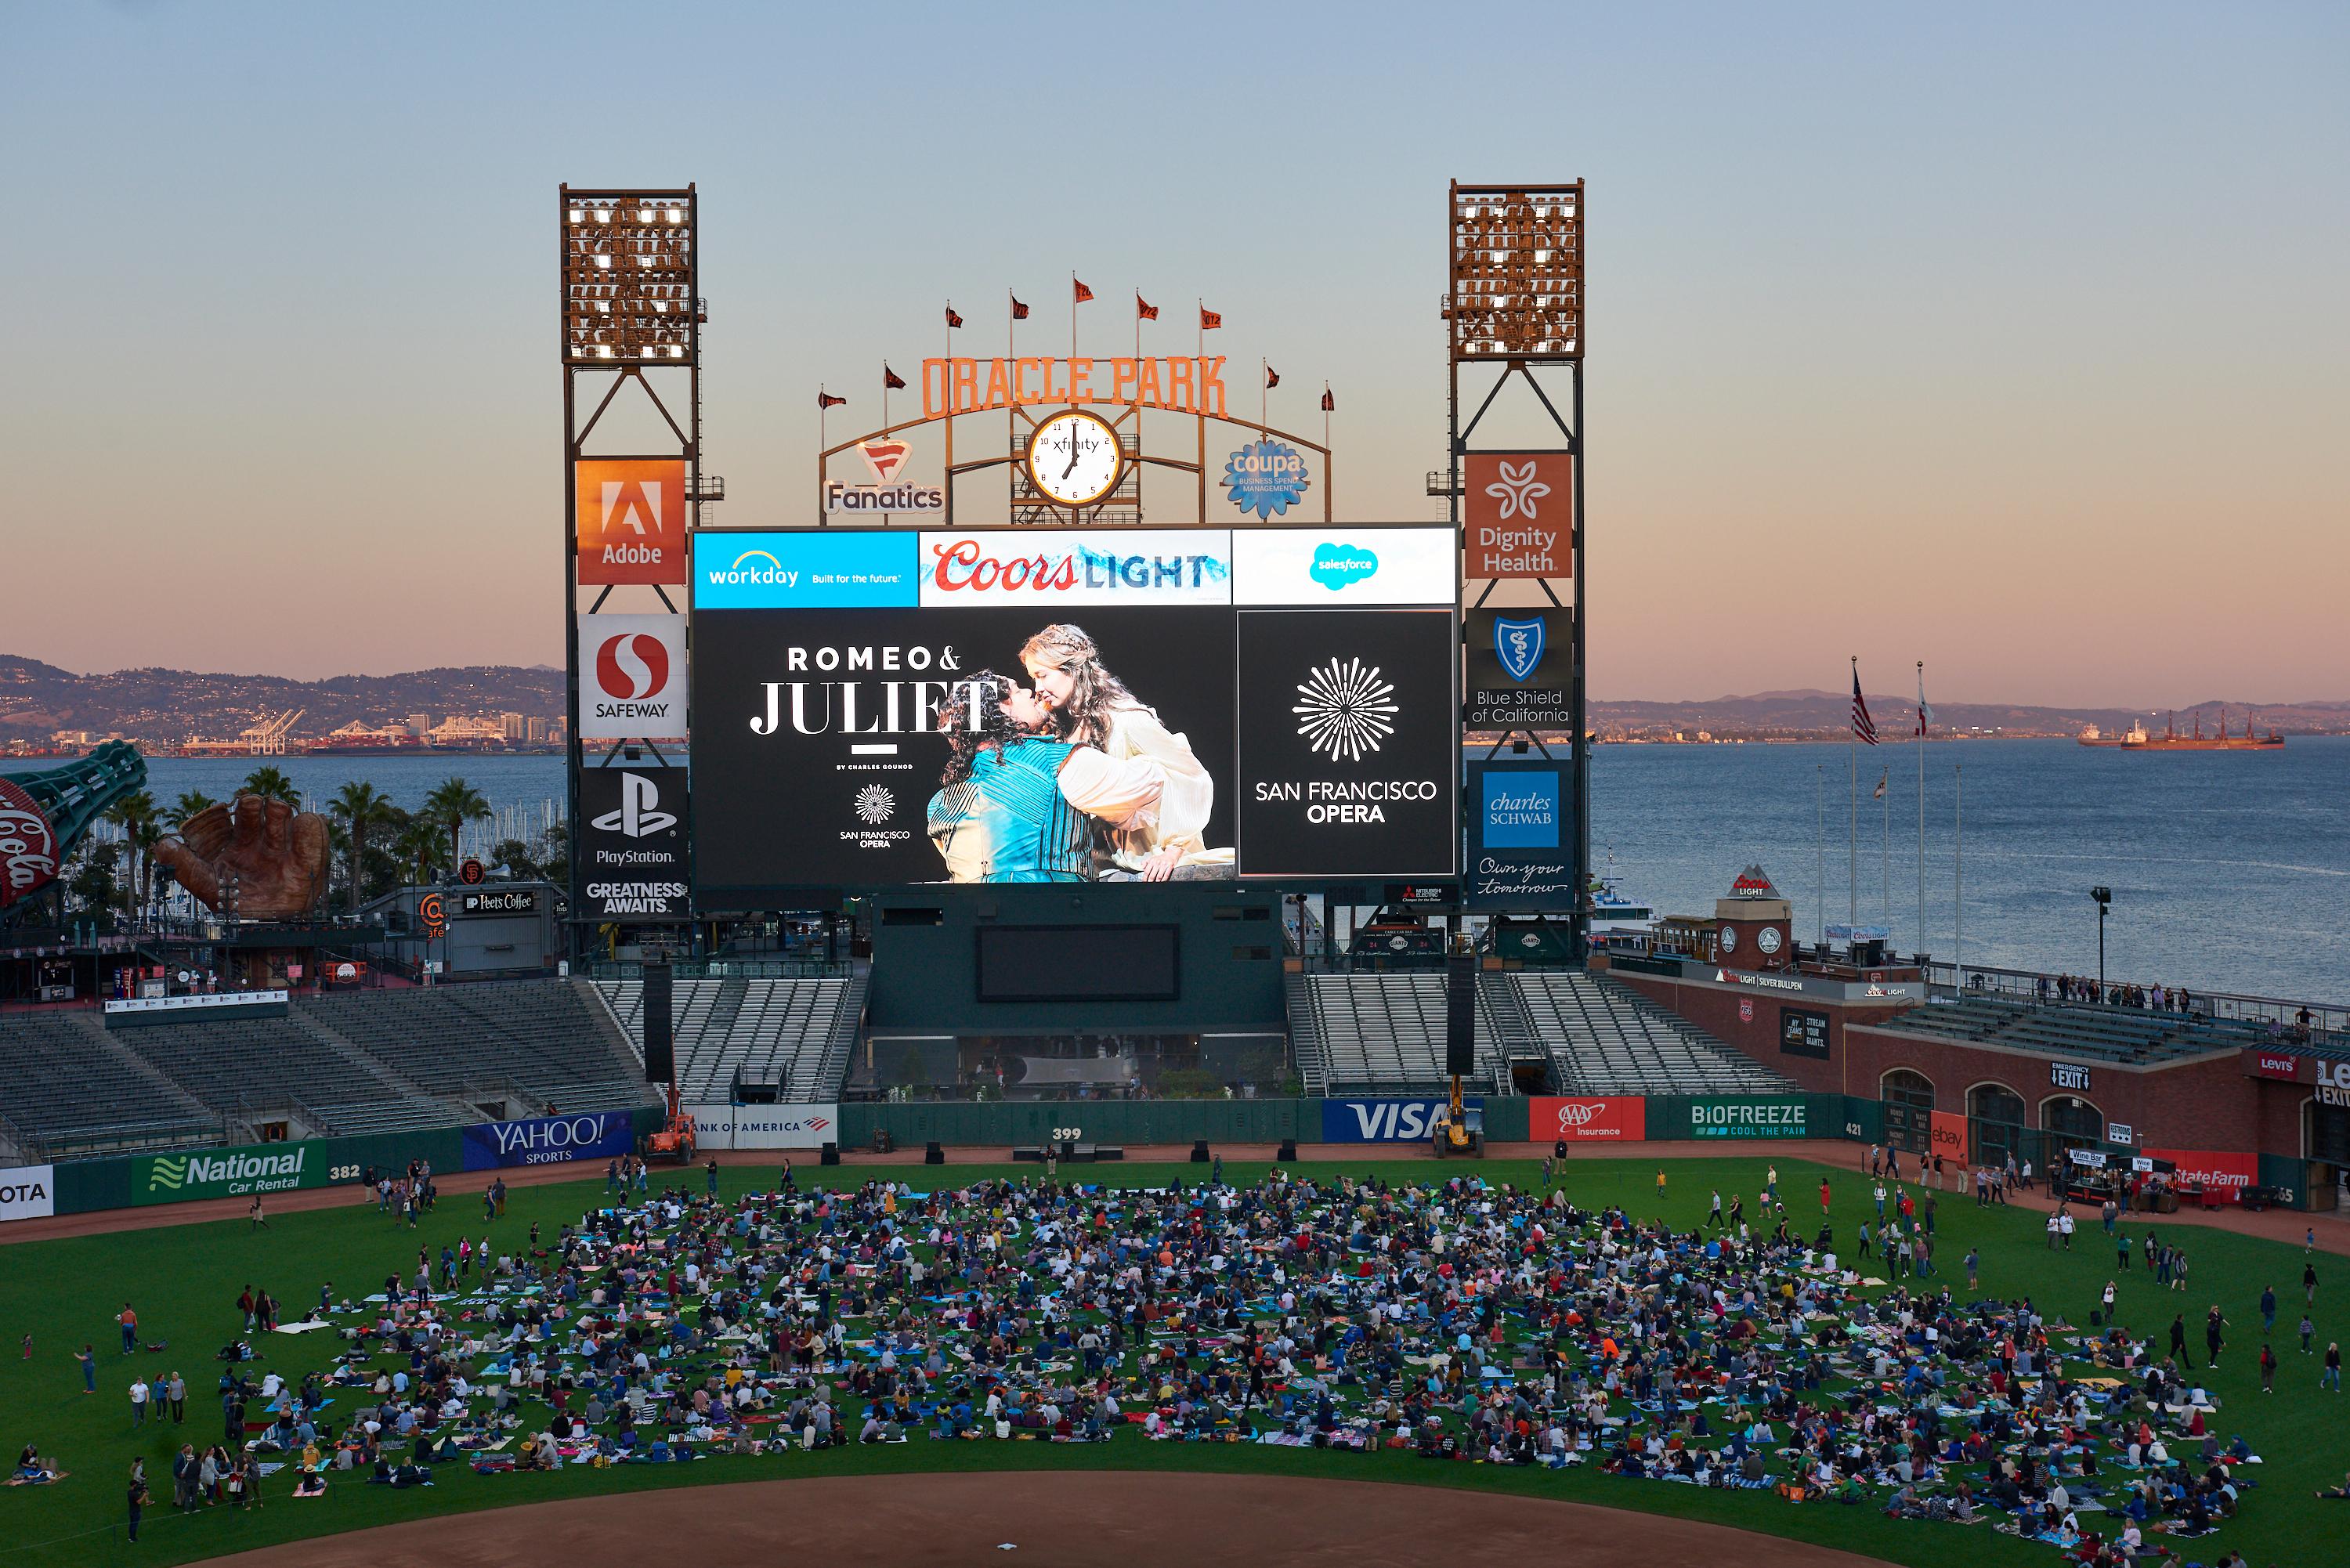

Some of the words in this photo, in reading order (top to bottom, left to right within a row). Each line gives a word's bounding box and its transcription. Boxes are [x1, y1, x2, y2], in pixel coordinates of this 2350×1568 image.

[923, 357, 1094, 420] ORACLE
[1111, 356, 1228, 420] PARK
[1234, 454, 1300, 477] coupa
[828, 484, 942, 509] Fanatics
[1479, 526, 1557, 551] Dignity
[602, 542, 662, 564] Adobe
[933, 540, 1079, 591] Coors
[1086, 555, 1209, 588] LIGHT
[1318, 558, 1372, 572] salesforce
[1484, 551, 1554, 572] Health
[709, 566, 799, 587] workday
[812, 574, 833, 583] Built
[836, 574, 849, 583] for
[852, 574, 866, 583] the
[787, 645, 932, 671] ROMEO
[939, 645, 962, 671] &
[1477, 691, 1511, 705] Blue
[1515, 690, 1562, 705] Shield
[595, 703, 668, 718] SAFEWAY
[749, 681, 998, 736] JULIET
[1472, 707, 1488, 722] of
[1491, 707, 1569, 722] California
[1255, 782, 1300, 801] SAN
[1308, 780, 1437, 800] FRANCISCO
[1491, 792, 1551, 811] charles
[1307, 804, 1385, 824] OPERA
[1490, 813, 1552, 824] SCHWAB
[840, 831, 858, 840] SAN
[860, 830, 910, 840] FRANCISCO
[859, 840, 891, 848] OPERA
[596, 850, 672, 866] PlayStation
[1479, 857, 1518, 875] Own
[1520, 865, 1564, 882] your
[1733, 874, 1770, 889] Coors
[587, 882, 682, 898] GREATNESS
[479, 894, 503, 909] Peet's
[504, 893, 532, 910] Coffee
[603, 898, 667, 913] AWAITS
[1853, 930, 1872, 939] Coors
[1740, 974, 1756, 984] LIGHT
[1759, 977, 1778, 988] SILVER
[1777, 980, 1802, 990] BULLPEN
[1806, 1017, 1826, 1028] STREAM
[1806, 1027, 1820, 1037] YOUR
[2052, 1062, 2090, 1073] EMERGENCY
[2058, 1069, 2083, 1089] EXIT
[722, 1123, 737, 1133] OF
[741, 1122, 801, 1132] AMERICA
[1346, 1103, 1449, 1140] VISA
[1846, 1122, 1861, 1136] 421
[493, 1115, 605, 1154] YAHOO!
[1052, 1128, 1082, 1140] 399
[1577, 1127, 1621, 1136] Insurance
[1932, 1125, 1962, 1150] ebay
[2110, 1125, 2131, 1136] RESTROOMS
[526, 1150, 573, 1165] SPORTS
[2073, 1150, 2089, 1160] Wine
[2091, 1153, 2102, 1162] Bar
[186, 1147, 306, 1184] National
[330, 1165, 360, 1180] 382
[228, 1180, 252, 1194] Car
[256, 1176, 299, 1191] Rental
